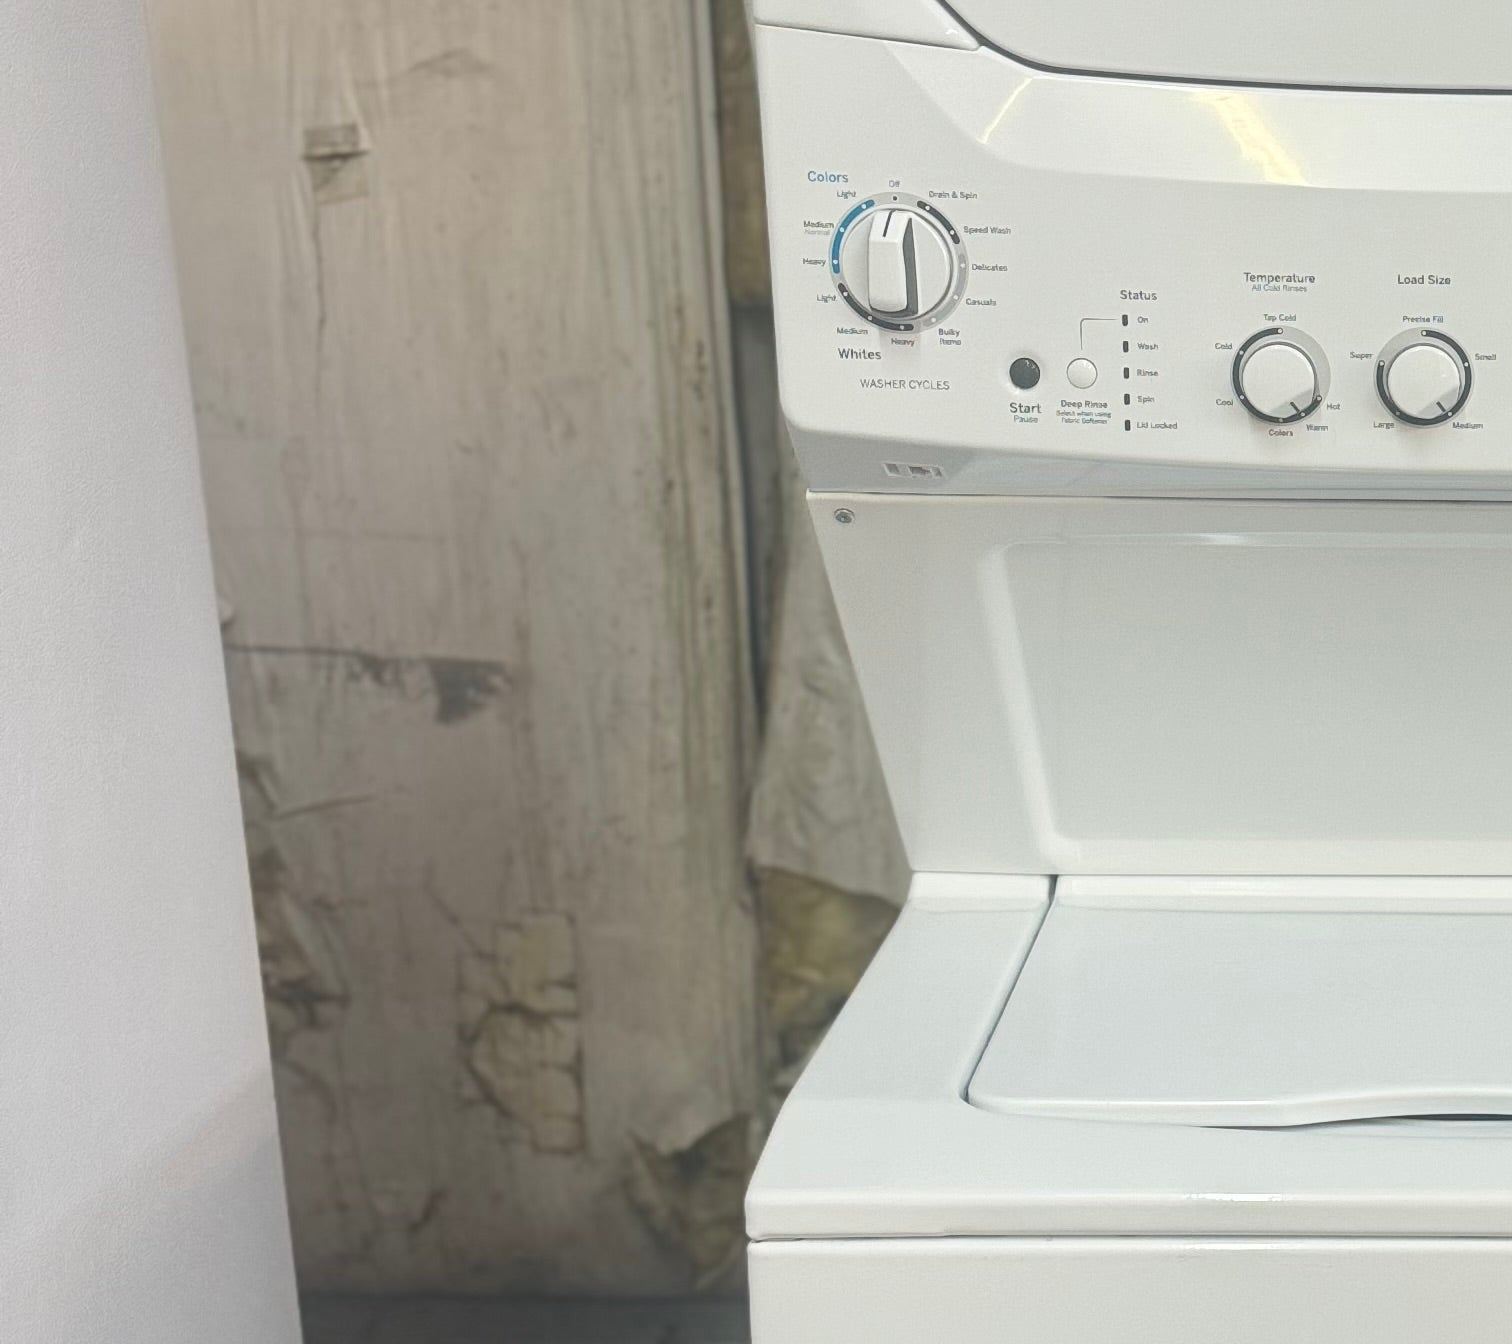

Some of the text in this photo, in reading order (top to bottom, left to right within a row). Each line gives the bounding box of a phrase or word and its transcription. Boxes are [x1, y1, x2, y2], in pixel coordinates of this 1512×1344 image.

[807, 170, 849, 183] Colors
[963, 226, 988, 234] Speed
[972, 263, 1008, 272] Delicates
[1243, 272, 1316, 285] Temperature
[1397, 274, 1451, 285] Load Size
[1120, 289, 1157, 301] Status
[1137, 316, 1148, 324] On
[1279, 314, 1297, 322] Cold
[1402, 315, 1444, 323] Precise Fill
[1215, 342, 1232, 350] Cold
[838, 347, 882, 360] Whites
[1350, 351, 1373, 360] Super
[1475, 352, 1497, 361] Small
[1137, 369, 1158, 377] Rinse
[860, 378, 950, 390] WASHER CYCLES
[1061, 399, 1108, 409] Deep Rinse
[1137, 396, 1155, 404] Spin
[1216, 398, 1233, 406] Cool
[1009, 402, 1042, 414] Start
[1373, 421, 1395, 430] Large
[1452, 421, 1484, 430] Medium
[1269, 429, 1294, 437] Colors
